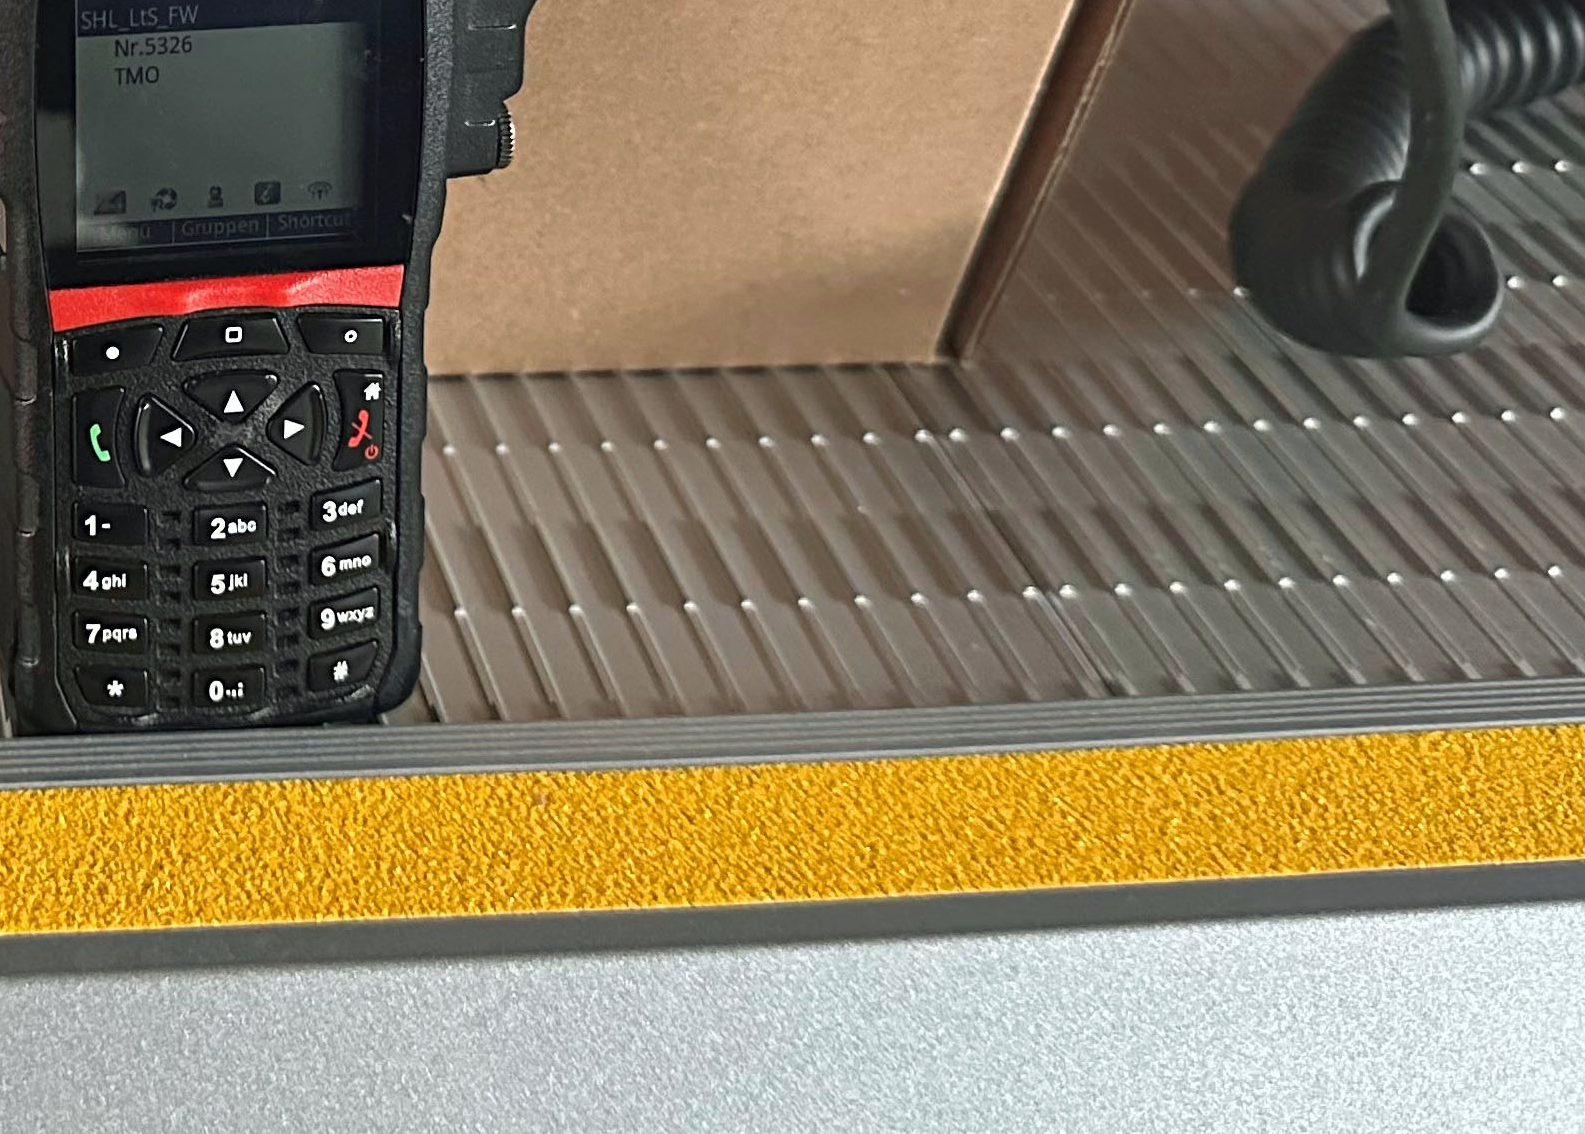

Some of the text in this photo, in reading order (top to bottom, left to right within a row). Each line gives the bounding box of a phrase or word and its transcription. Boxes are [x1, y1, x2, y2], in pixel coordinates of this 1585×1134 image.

[115, 35, 193, 57] Nr.5326
[115, 66, 160, 85] TMO
[182, 216, 259, 237] Gruppen
